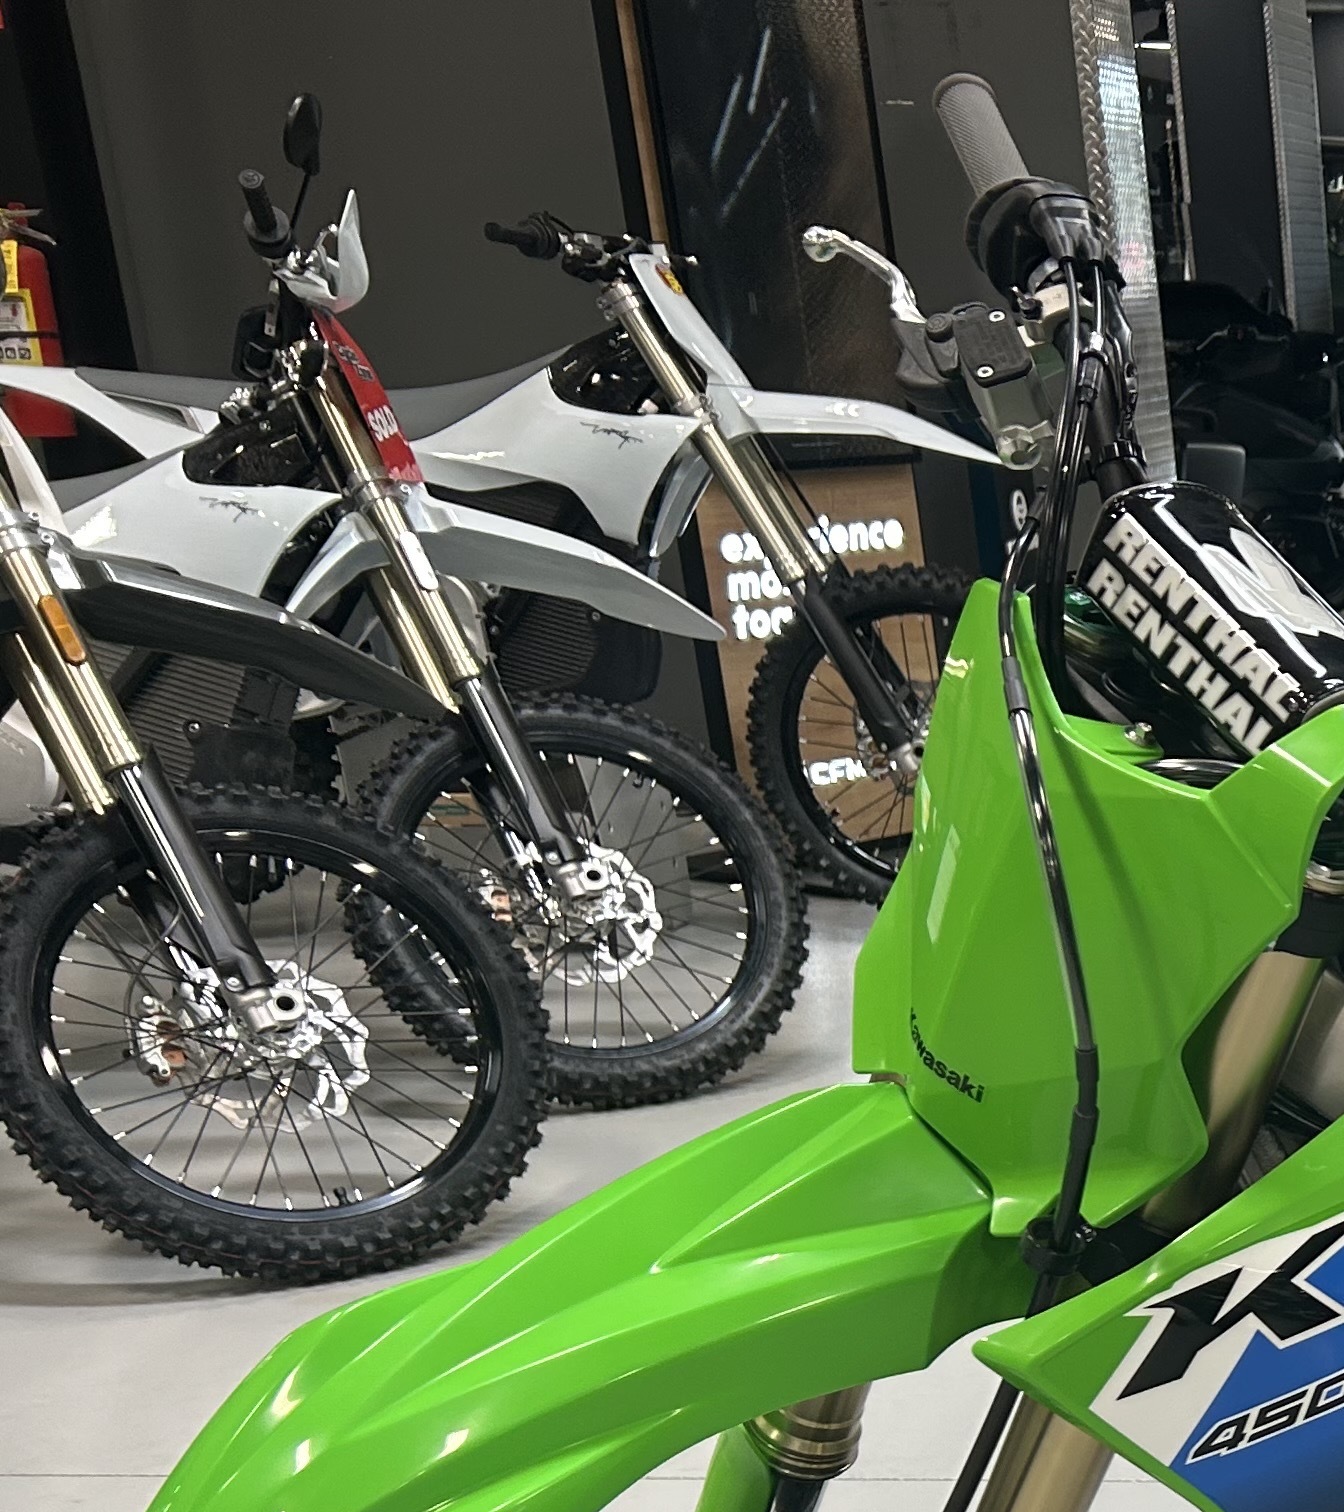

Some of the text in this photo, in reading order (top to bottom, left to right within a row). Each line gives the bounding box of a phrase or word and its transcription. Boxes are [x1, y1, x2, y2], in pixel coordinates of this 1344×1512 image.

[367, 404, 400, 442] SOLD
[1085, 557, 1274, 758] RENTHAL
[1103, 512, 1302, 723] RENTHAL
